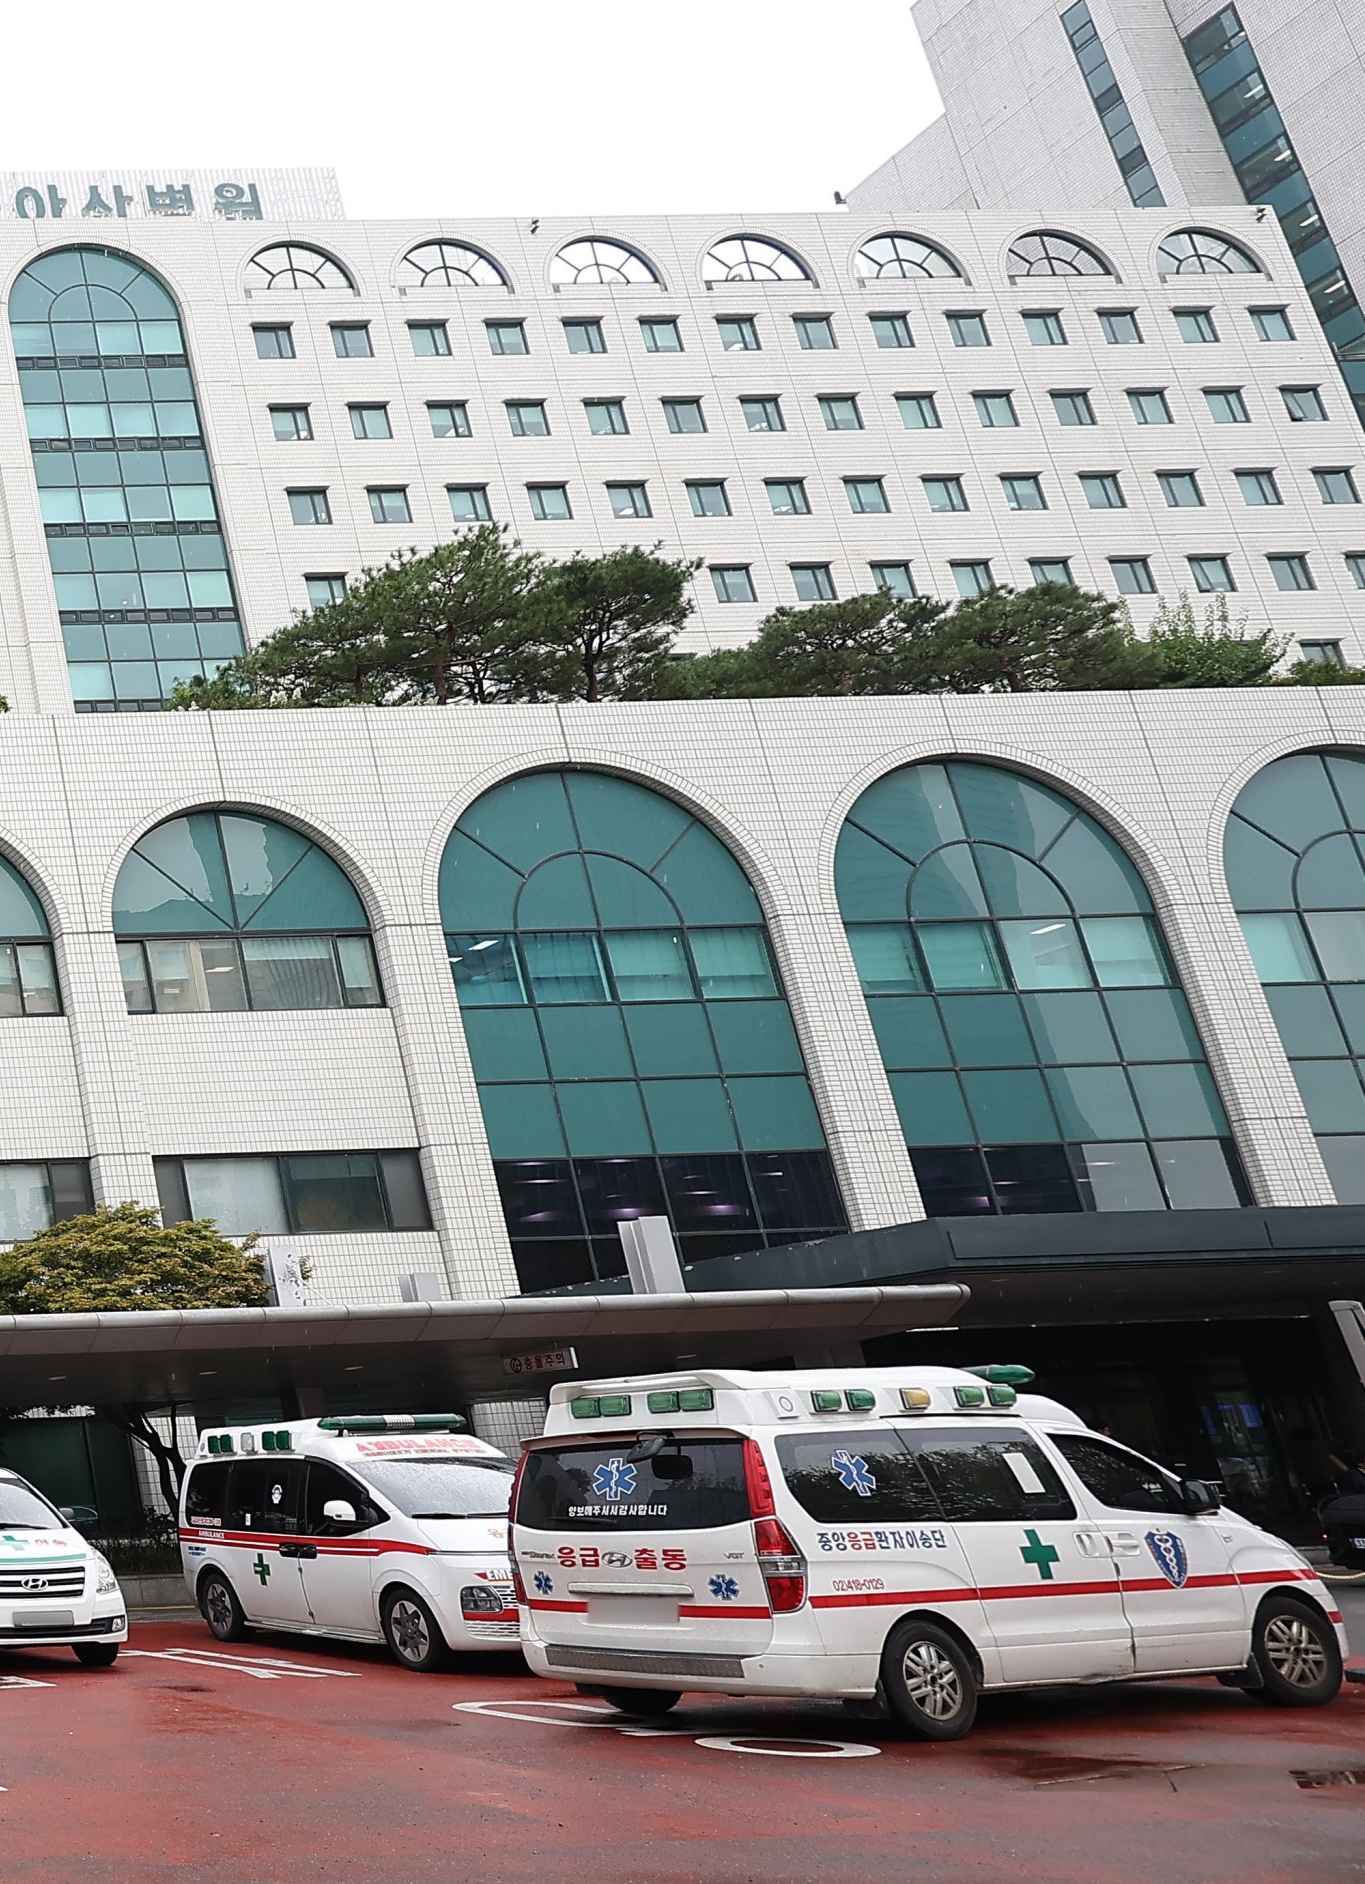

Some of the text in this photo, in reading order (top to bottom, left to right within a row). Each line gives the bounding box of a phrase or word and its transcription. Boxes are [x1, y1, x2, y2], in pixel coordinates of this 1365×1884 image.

[524, 1352, 565, 1371] 충돌주의
[355, 1438, 481, 1453] AMBULANCE
[817, 1530, 947, 1551] 중앙응급환자이송단
[557, 1546, 688, 1570] 응급 출동
[723, 1552, 745, 1560] VGT
